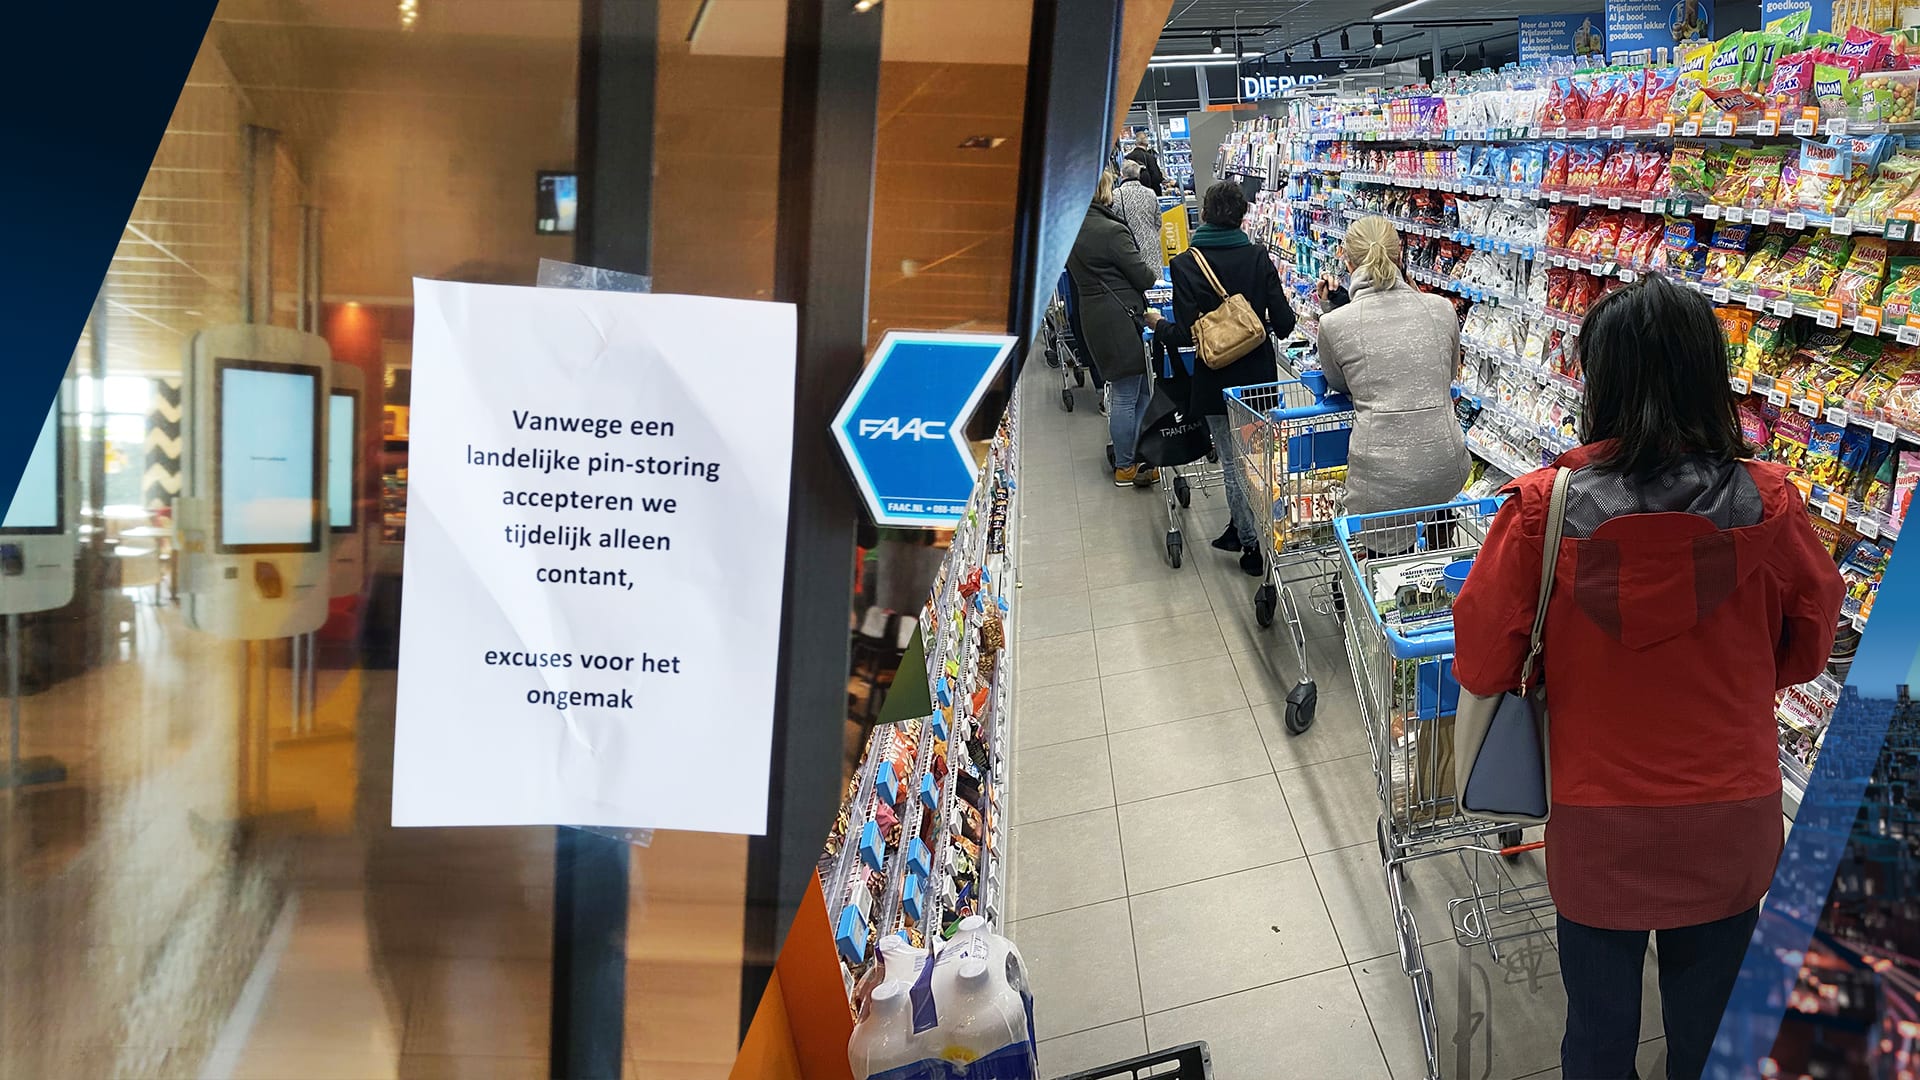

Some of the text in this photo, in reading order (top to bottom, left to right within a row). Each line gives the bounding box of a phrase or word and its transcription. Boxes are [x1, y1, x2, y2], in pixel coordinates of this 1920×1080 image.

[1608, 4, 1661, 14] Prijsfavorieten.
[1618, 14, 1625, 23] je
[1609, 21, 1665, 31] schappen lekker
[1609, 32, 1644, 41] goedkoop.
[1816, 80, 1842, 97] MAOAM
[1807, 144, 1837, 159] HARIBO
[513, 409, 674, 438] Vanwege een
[859, 417, 945, 442] FAAC
[467, 445, 720, 482] landelijke pin-storing
[502, 490, 677, 513] accepteren we
[505, 524, 671, 551] tijdelijk alleen
[536, 566, 634, 591] contant,
[484, 650, 681, 673] excuses voor het
[526, 689, 633, 711] ongemak
[1788, 686, 1823, 720] HARIBO
